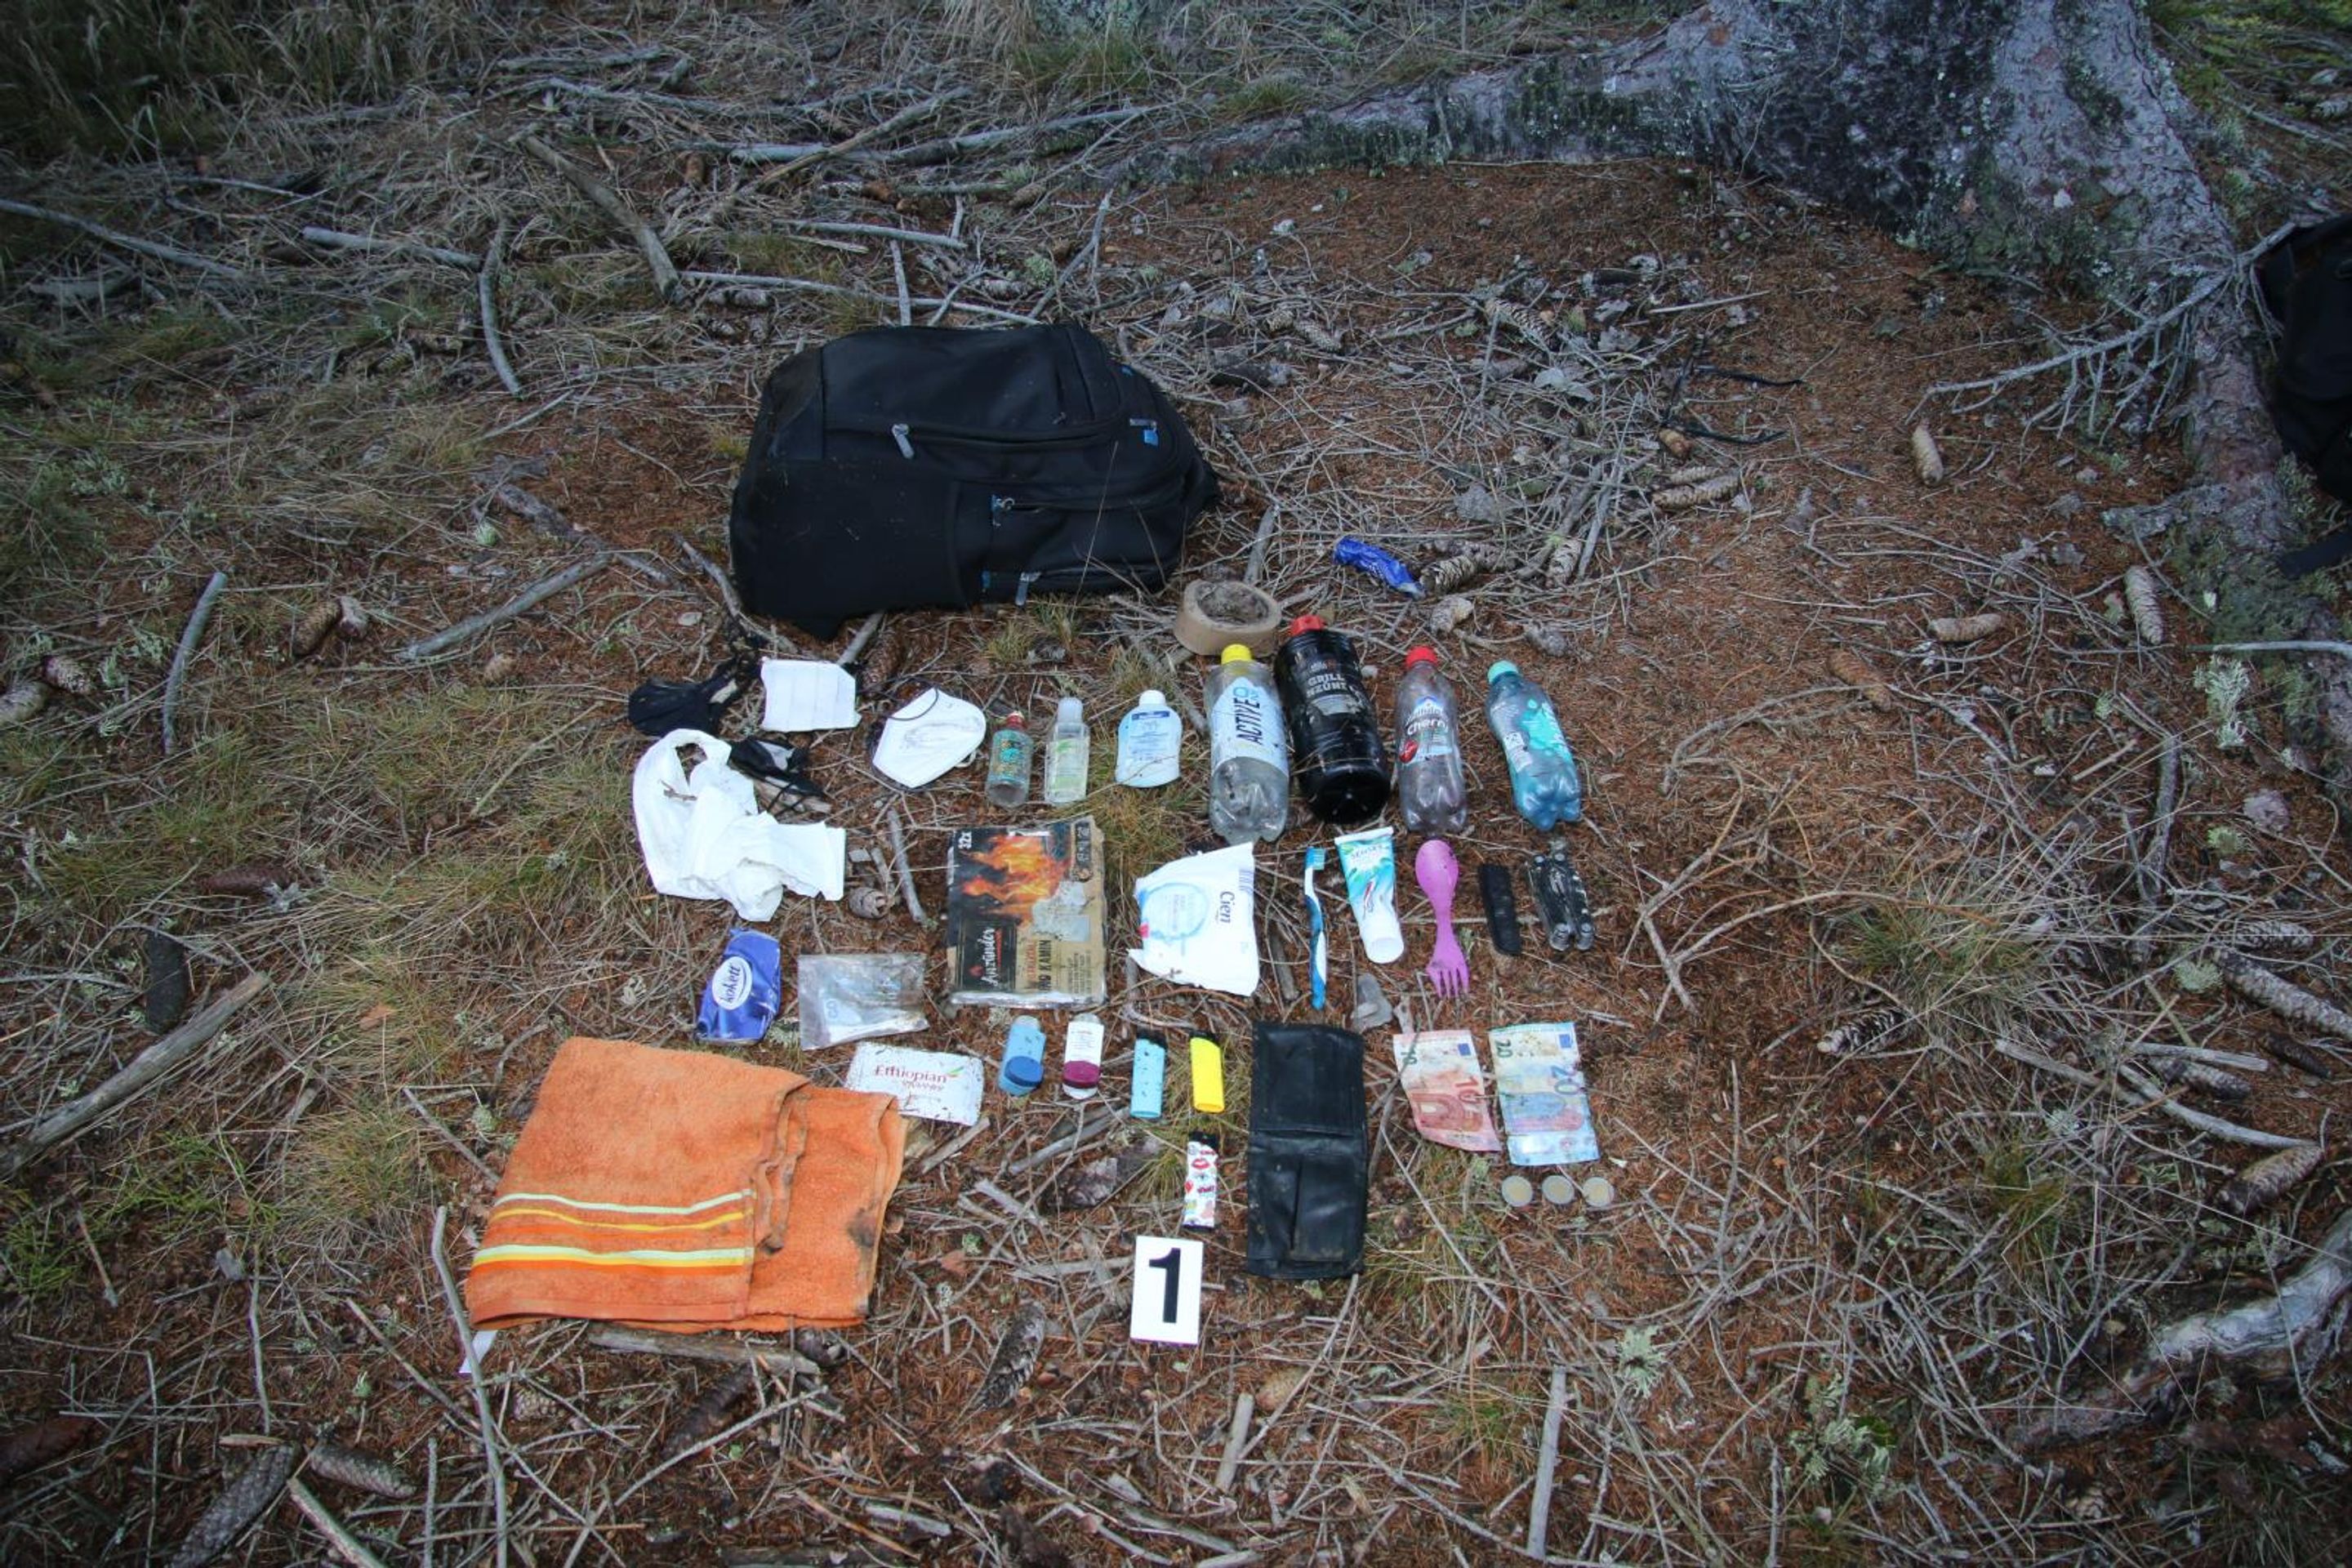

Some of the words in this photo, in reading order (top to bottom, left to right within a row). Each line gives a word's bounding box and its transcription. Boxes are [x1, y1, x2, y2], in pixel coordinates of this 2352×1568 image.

[1233, 697, 1263, 745] ACTIVE
[1219, 891, 1236, 924] Cien
[1495, 1039, 1512, 1058] 20
[875, 1064, 947, 1084] Ethiopian
[1148, 1247, 1181, 1324] 1
